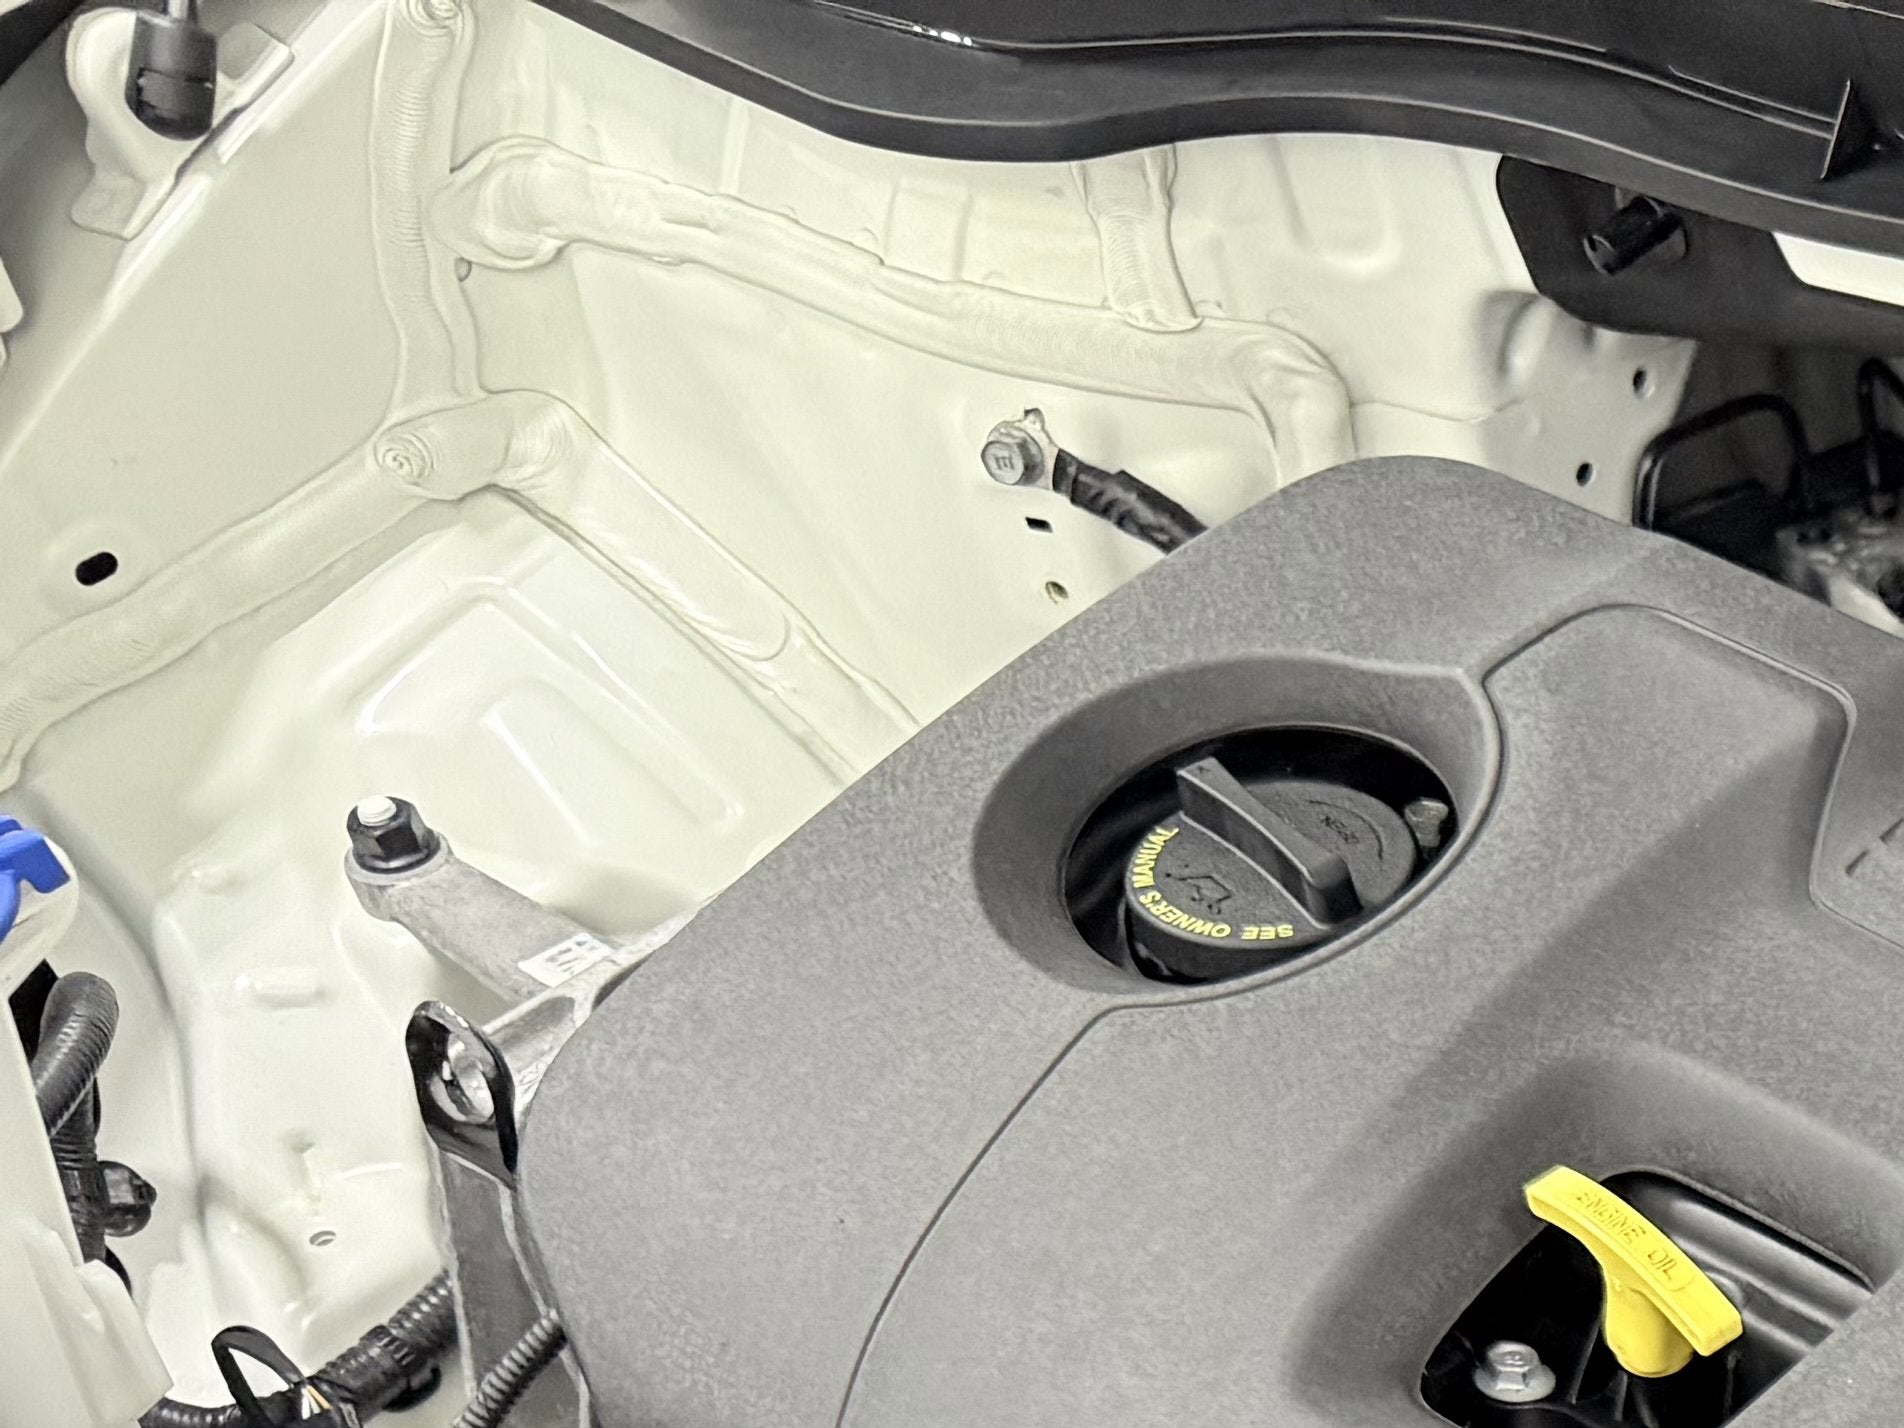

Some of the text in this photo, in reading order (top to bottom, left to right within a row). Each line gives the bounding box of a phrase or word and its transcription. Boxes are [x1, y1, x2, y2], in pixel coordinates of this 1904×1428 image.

[1131, 826, 1294, 940] SEE OWNER'S MANUAL
[1574, 1188, 1683, 1282] ENGINE OIL
